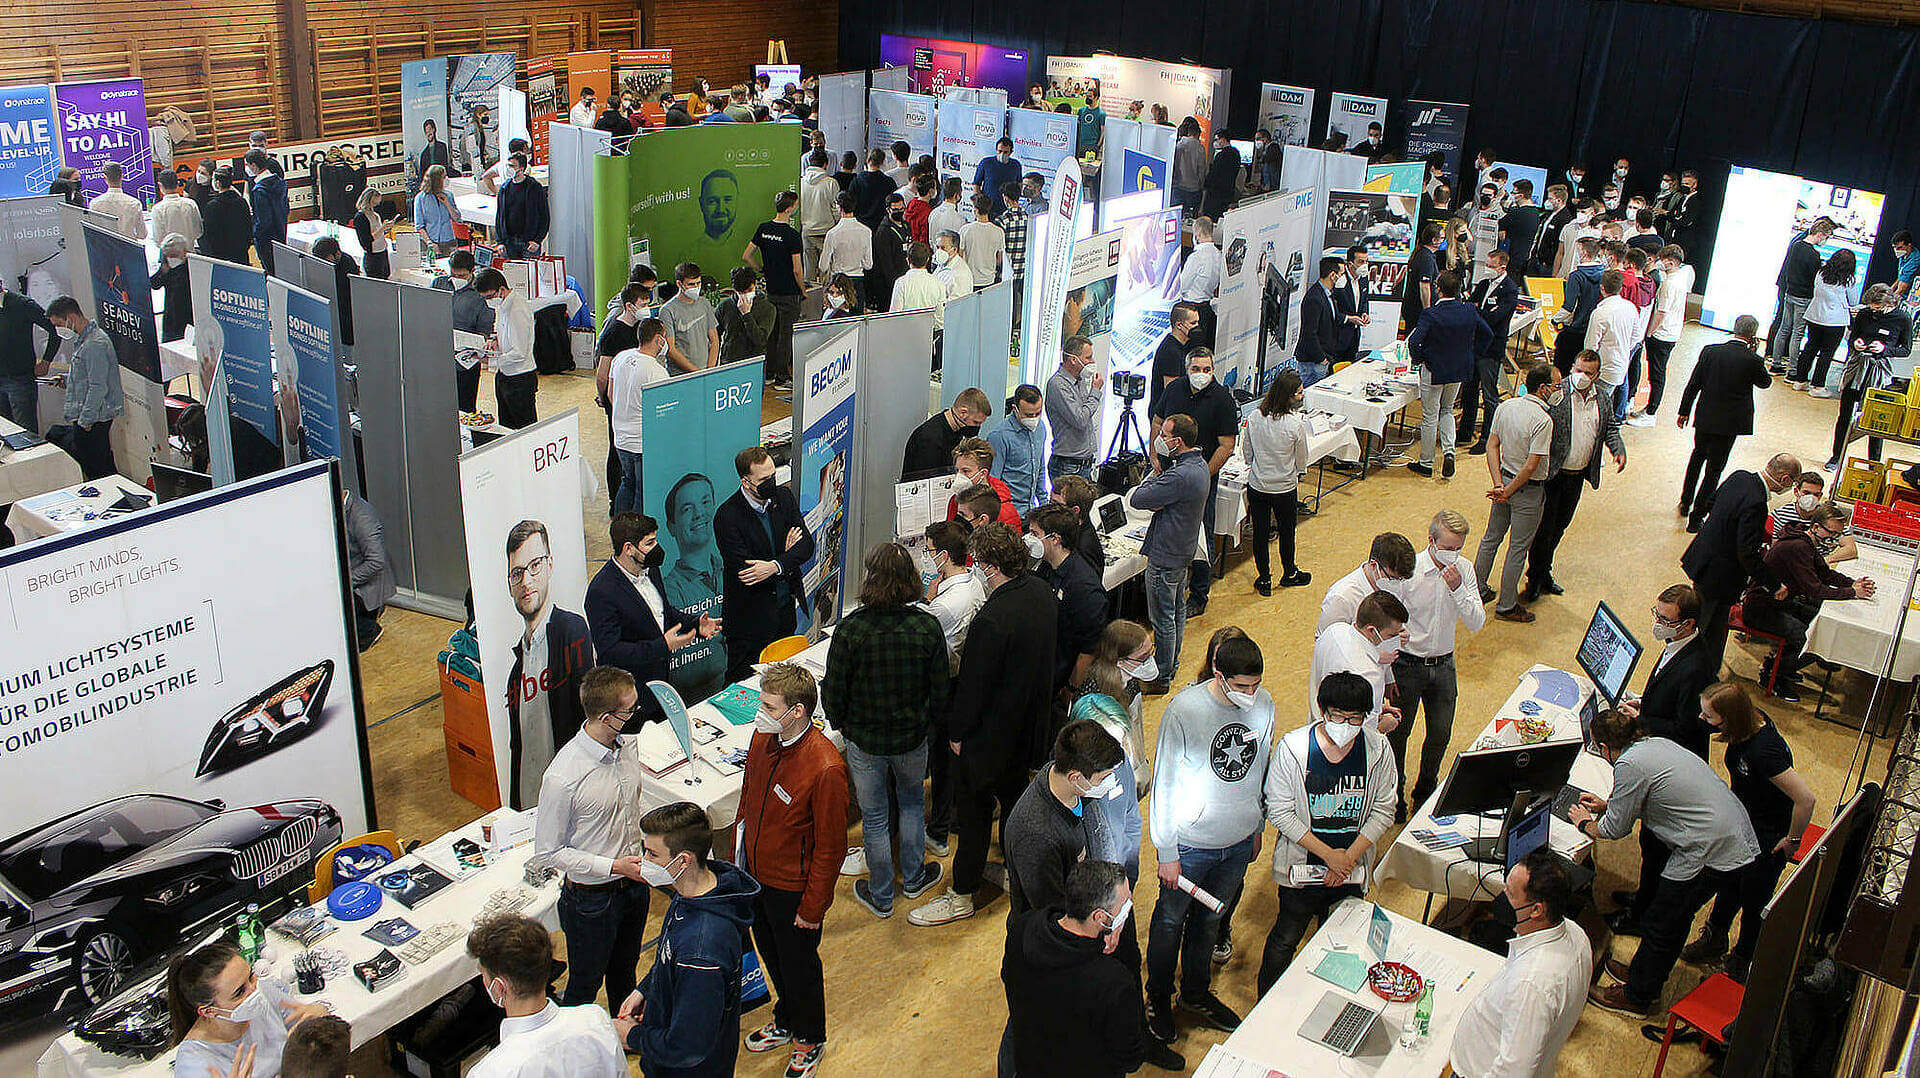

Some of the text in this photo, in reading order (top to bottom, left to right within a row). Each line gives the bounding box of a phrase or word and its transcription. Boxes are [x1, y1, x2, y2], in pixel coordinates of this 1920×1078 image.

[1280, 92, 1303, 103] DAM
[1351, 102, 1375, 114] DAM
[0, 118, 51, 147] ME
[65, 110, 127, 132] SAY HI
[974, 123, 996, 134] nova
[66, 132, 130, 153] TO A.I.
[1046, 132, 1069, 143] nova
[655, 190, 674, 204] with
[675, 186, 690, 200] us!
[1295, 191, 1313, 210] PKE
[213, 288, 265, 311] SOFTLINE
[1368, 280, 1394, 295] KE
[103, 301, 141, 329] SEADEV
[104, 318, 143, 344] STUDIOS
[288, 314, 330, 344] SOFTLINE
[811, 348, 852, 398] BECOM
[715, 381, 753, 412] BRZ
[533, 436, 570, 473] BRZ
[27, 546, 143, 592] BRIGHT MINDS,
[68, 557, 183, 604] BRIGHT LIGHTS.
[680, 597, 713, 615] rreich
[0, 615, 196, 697] IUM LICHTSYSTEME
[681, 647, 713, 665] Ihnen.
[0, 653, 168, 727] ÜR DIE GLOBALE
[0, 668, 198, 757] OMOBILINDUSTRIE
